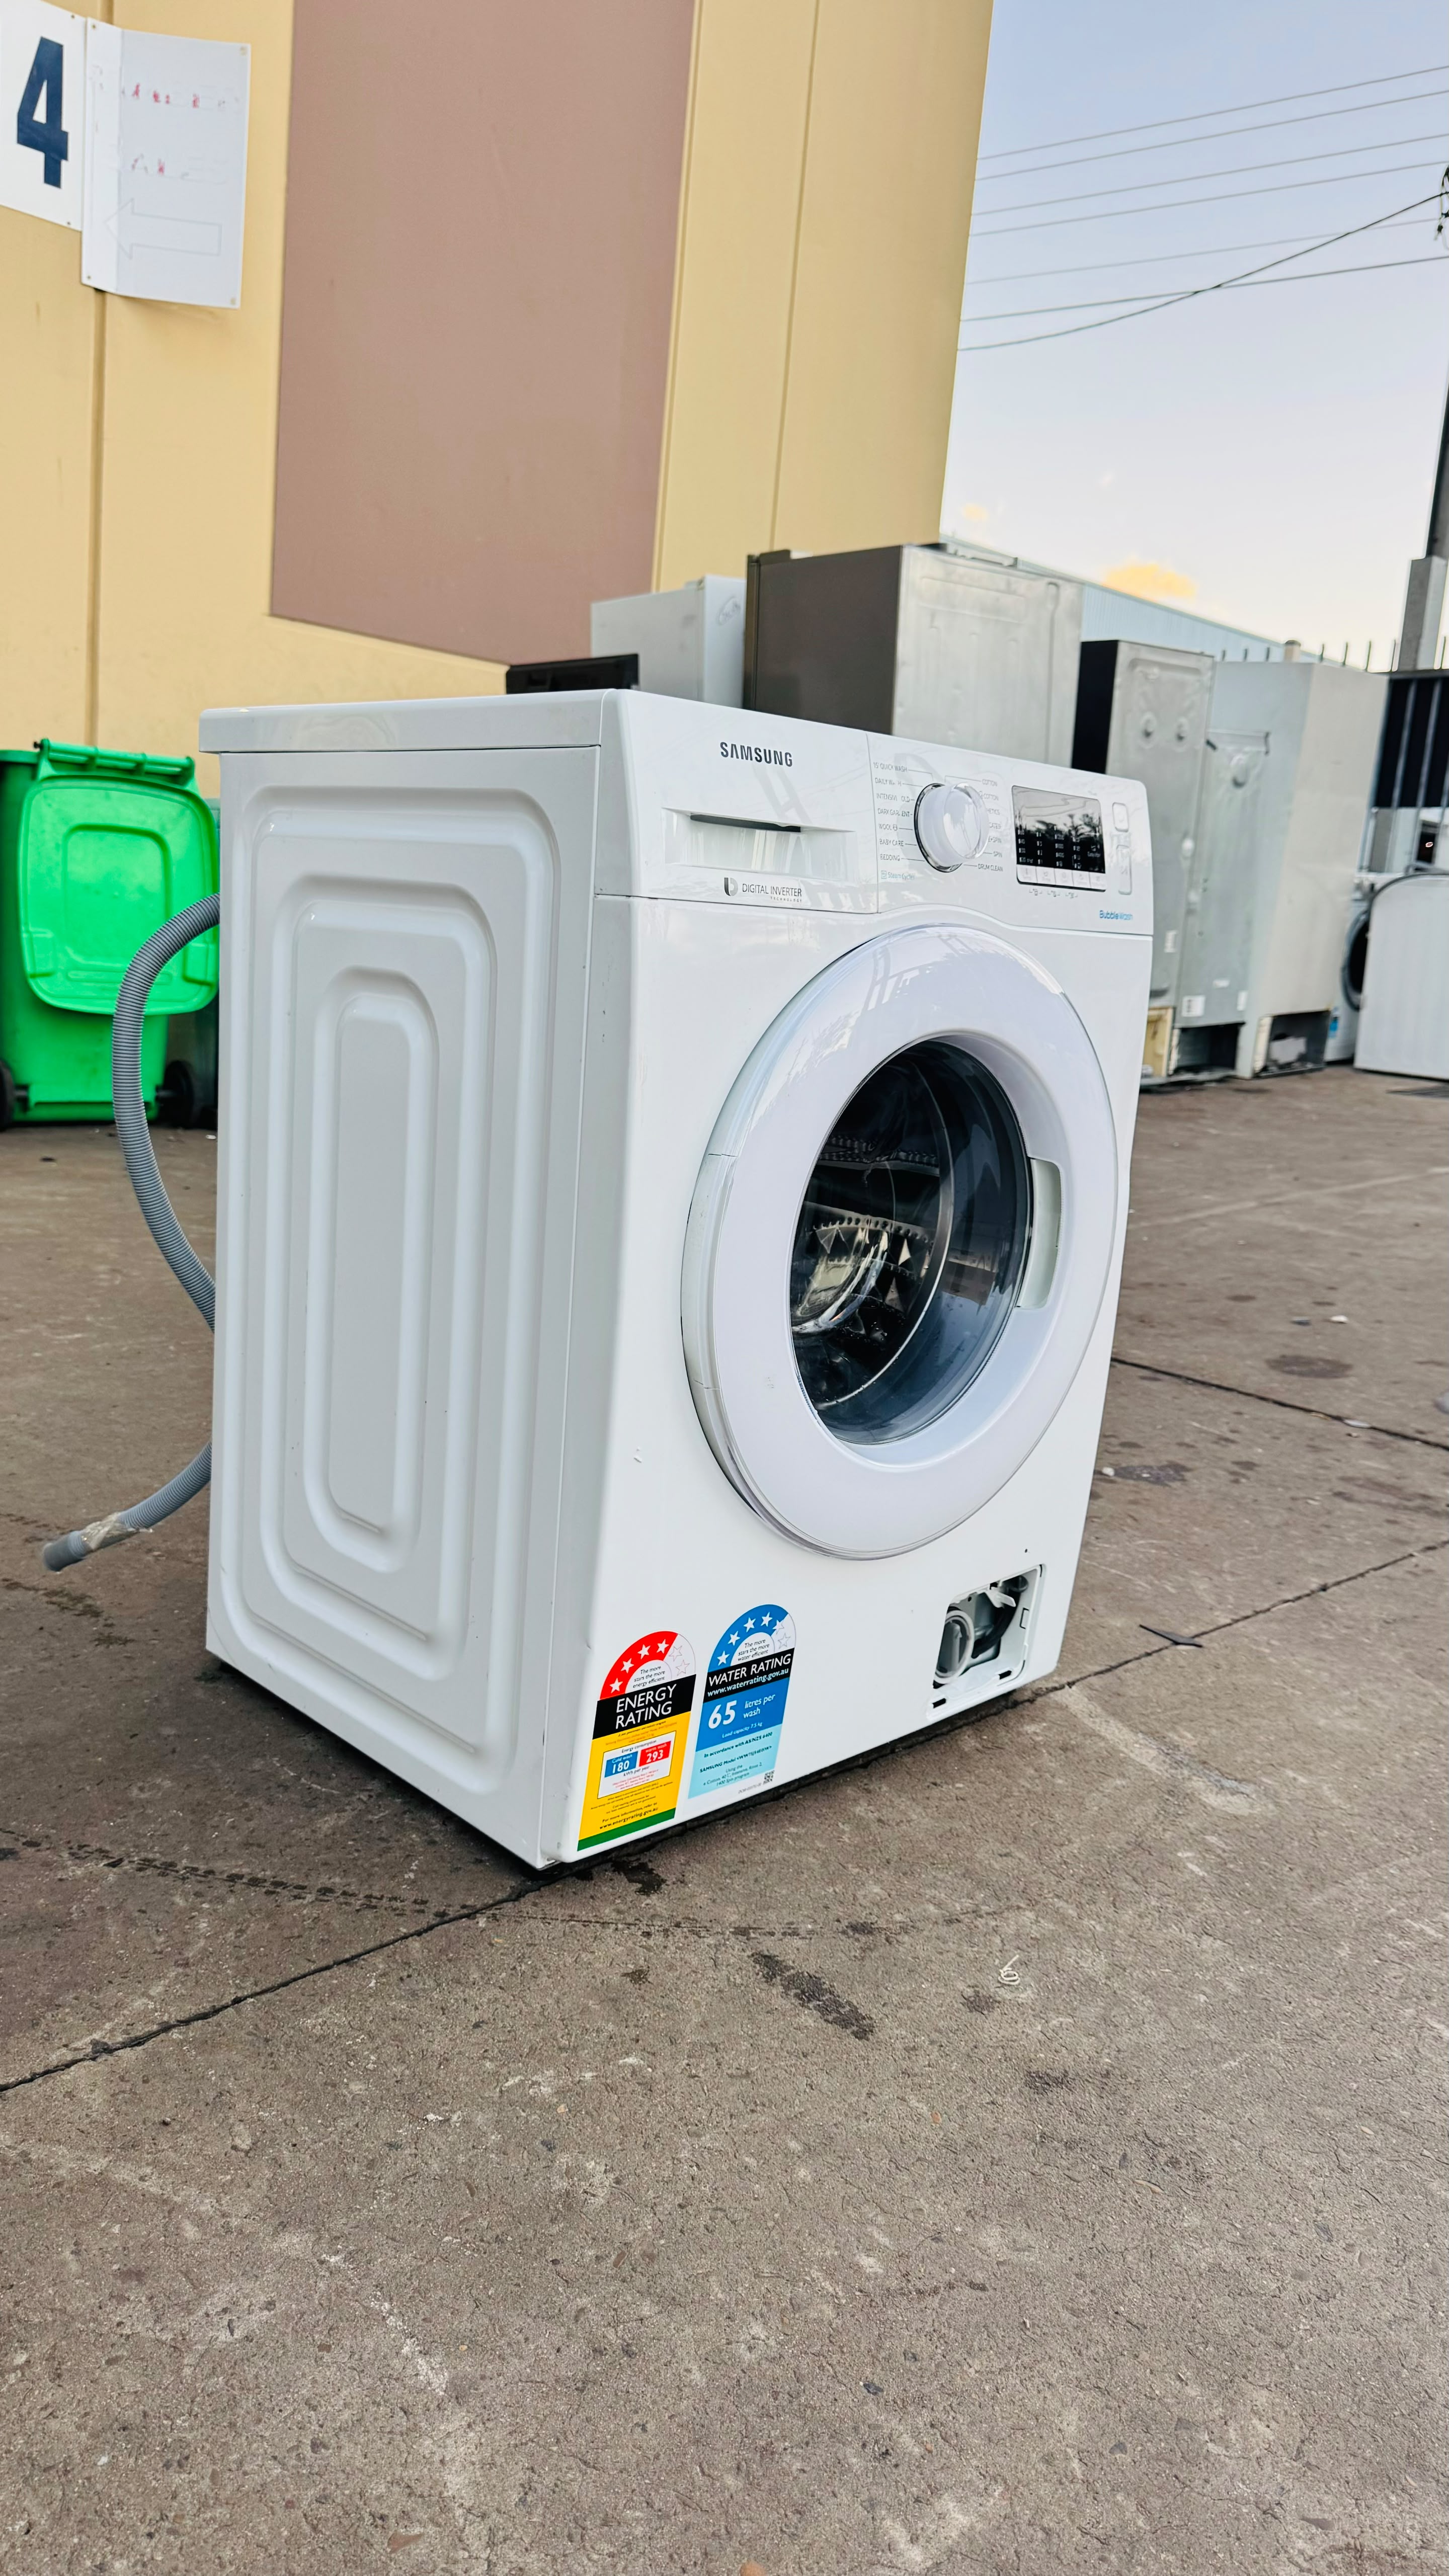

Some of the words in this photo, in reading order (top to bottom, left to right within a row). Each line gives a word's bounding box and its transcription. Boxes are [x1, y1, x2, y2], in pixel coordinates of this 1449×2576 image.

[17, 36, 68, 189] 4
[720, 742, 792, 767] SAMSUNG
[742, 883, 769, 894] DIGITAL
[770, 886, 802, 897] INVERTER
[752, 1650, 768, 1658] efficient
[708, 1667, 747, 1686] WATER
[751, 1654, 791, 1675] RATING
[707, 1668, 789, 1697] www.waterrating.gov.au
[616, 1684, 677, 1713] ENERGY
[615, 1701, 672, 1729] RATING
[708, 1700, 737, 1729] 65
[745, 1699, 762, 1709] litres
[763, 1694, 775, 1705] per
[743, 1707, 761, 1719] wash
[734, 1726, 750, 1735] capacity
[646, 1749, 663, 1763] 293
[709, 1745, 734, 1756] accordance
[612, 1760, 629, 1774] 180
[700, 1762, 722, 1773] SAMSUNG
[600, 1807, 658, 1829] www.energyrating.gov.au
